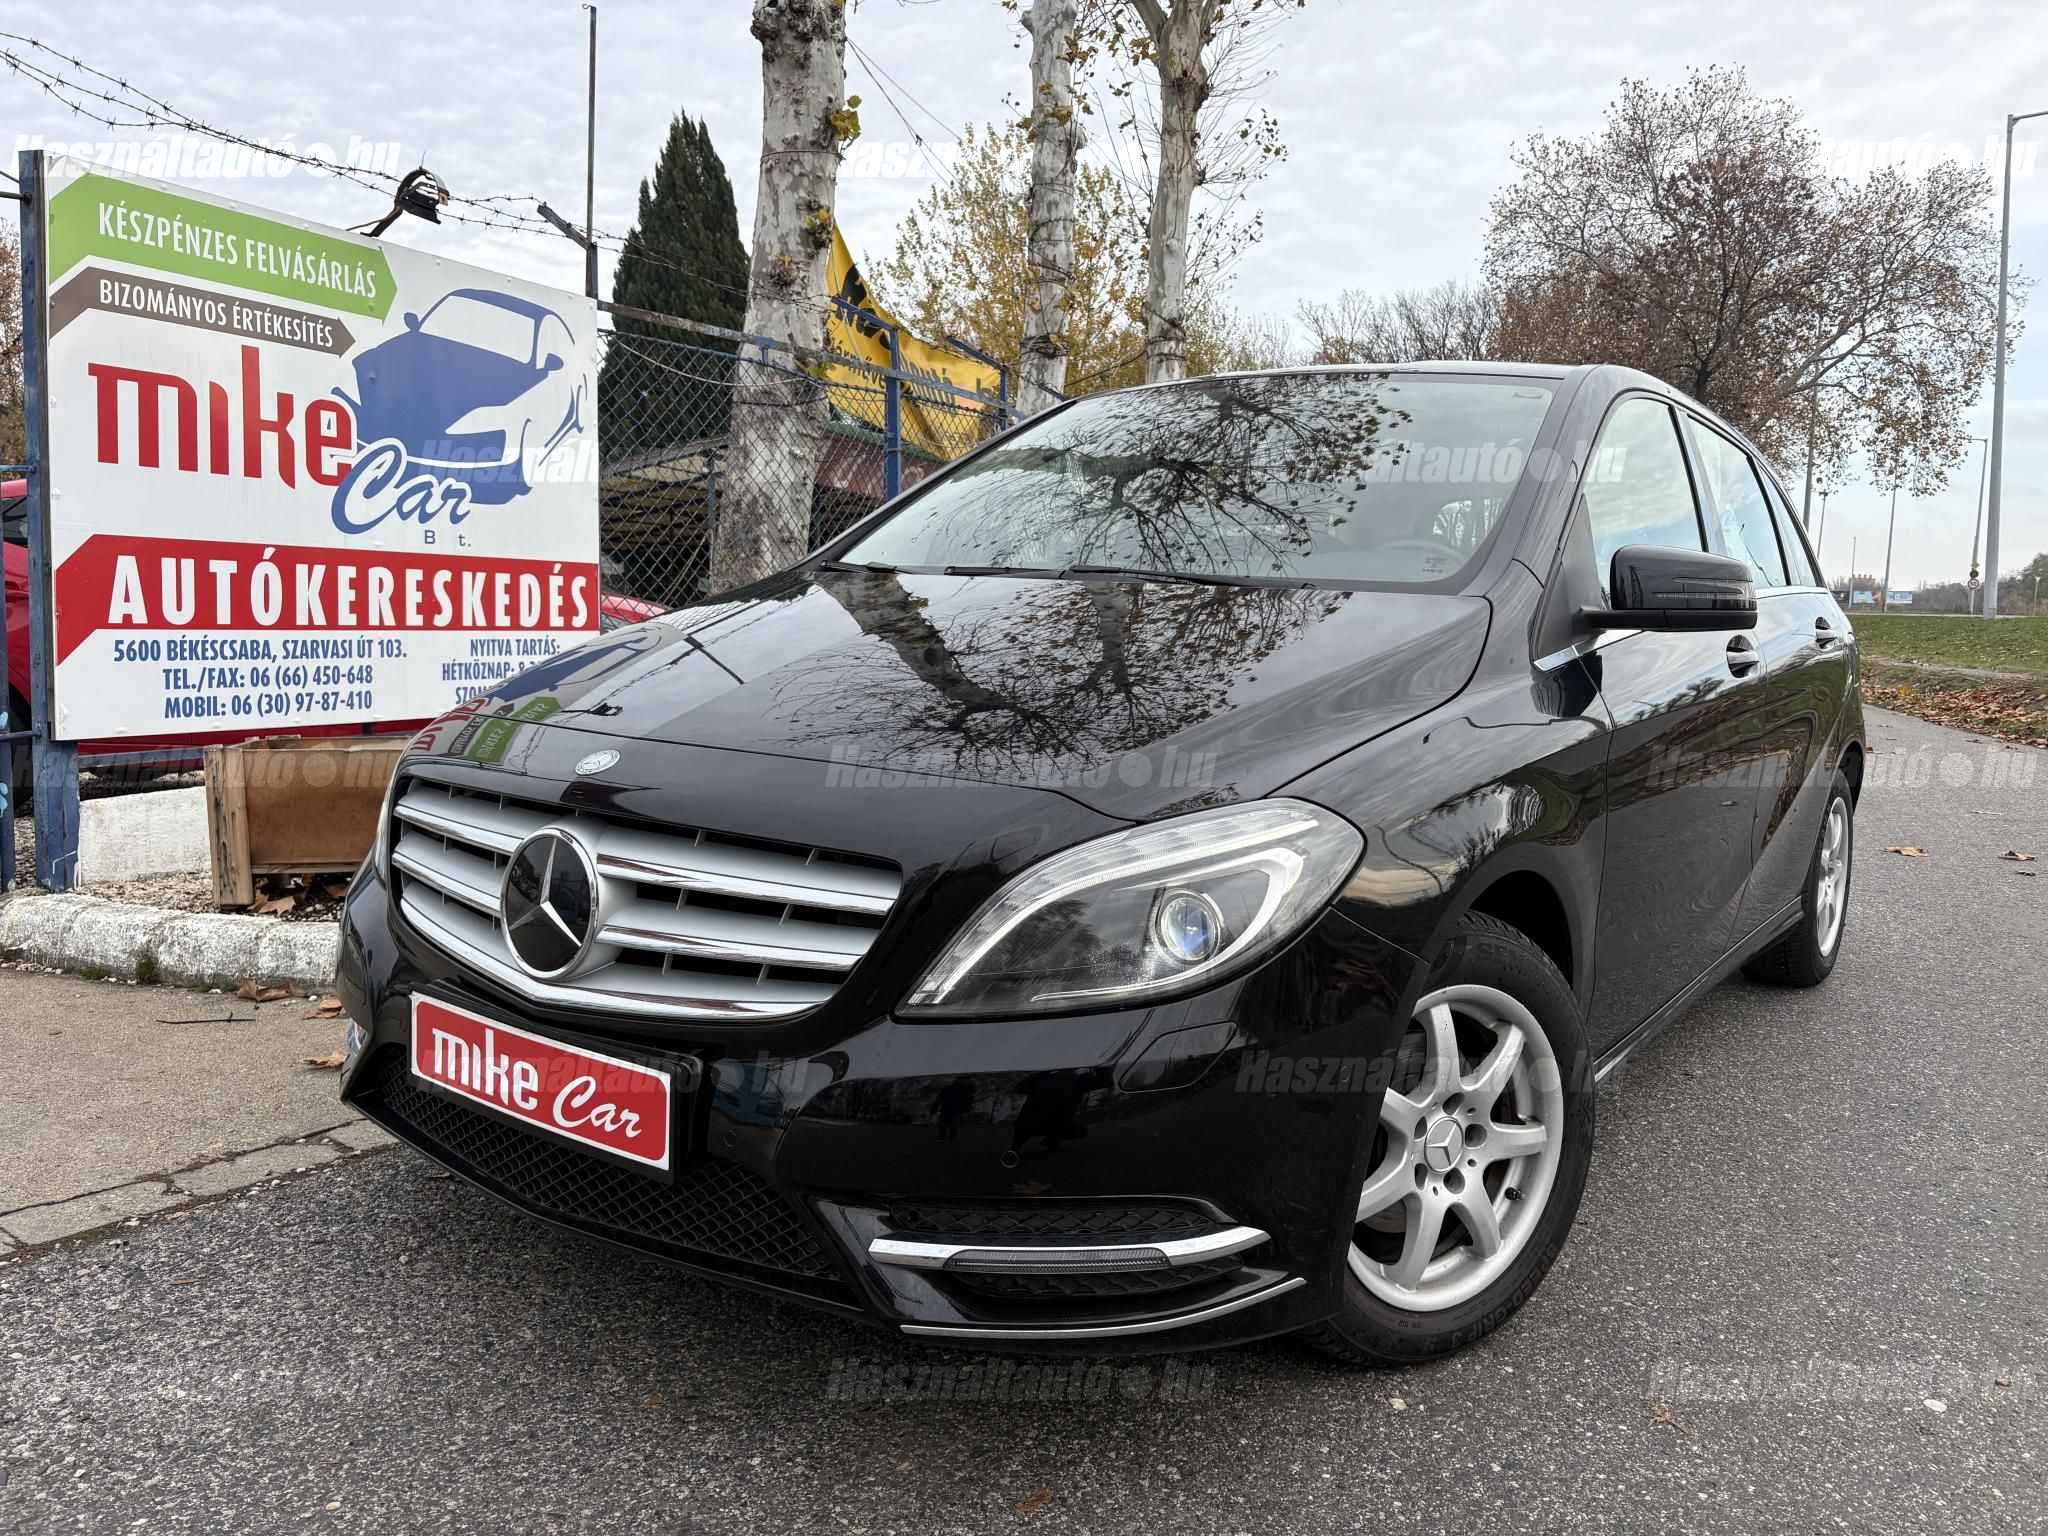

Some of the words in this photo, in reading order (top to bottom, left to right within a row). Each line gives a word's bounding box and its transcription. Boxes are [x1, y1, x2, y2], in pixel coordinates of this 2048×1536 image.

[98, 201, 238, 267] KÉSZPÉNZES
[245, 236, 377, 299] FELVÁSÁRLÁS
[99, 279, 227, 327] BIZOMÁNYOS
[232, 299, 333, 348] ÉRTÉKESÍTÉS
[88, 345, 353, 490] mike
[331, 440, 474, 535] Car
[424, 530, 436, 545] B
[107, 546, 590, 629] AUTÓKERESKEDÉS
[113, 638, 162, 663] 5600
[167, 633, 277, 664] BÉKÉSCSABA,
[281, 638, 353, 662] SZARVASI
[355, 633, 374, 660] ÚT
[378, 638, 408, 660] 103.
[163, 667, 246, 692] TEL./FAX:
[250, 667, 271, 690] 06
[274, 666, 309, 690] (66)
[312, 664, 374, 688] 450-648
[470, 638, 513, 657] NYITVA
[515, 634, 561, 656] TARTÁS:
[164, 694, 227, 719] MOBIL:
[231, 694, 253, 716] 06
[256, 692, 292, 717] (30)
[295, 691, 373, 714] 97-87-410
[432, 1028, 538, 1110] mike
[552, 1075, 643, 1139] Car
